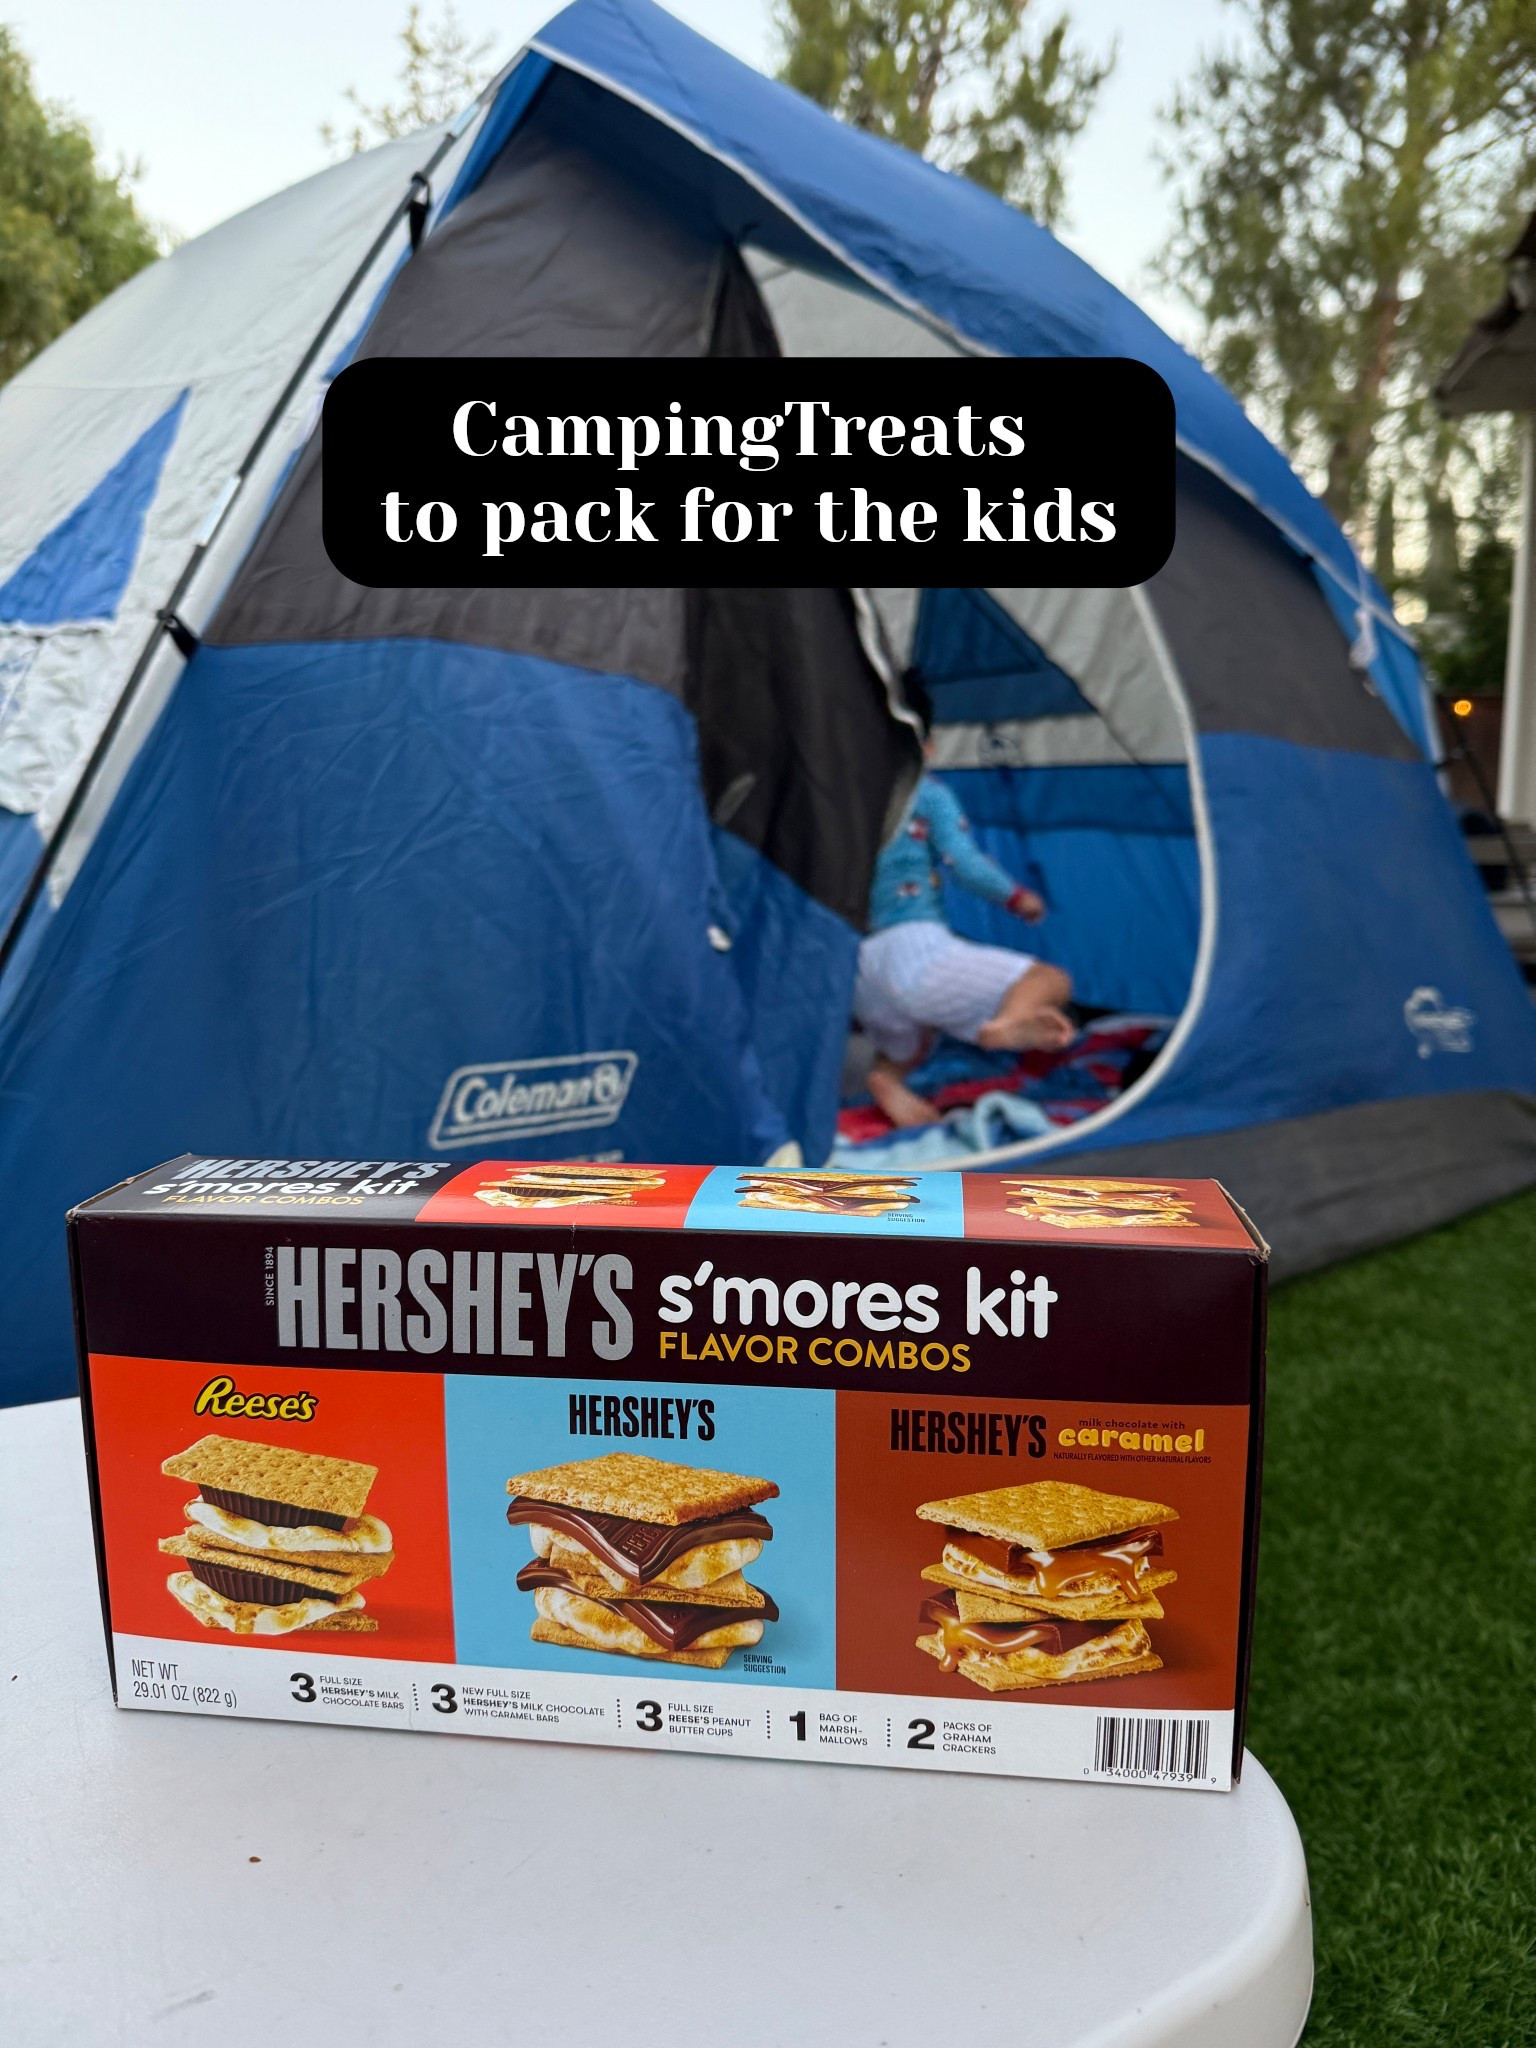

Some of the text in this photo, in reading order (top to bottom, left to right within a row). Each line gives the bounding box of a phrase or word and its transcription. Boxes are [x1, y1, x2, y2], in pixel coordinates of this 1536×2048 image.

[171, 1159, 451, 1180] HERSHEY'S
[142, 1179, 419, 1196] s'mores kit
[161, 1195, 367, 1206] FLAVOR COMBOS
[264, 1246, 275, 1306] SINCE 1894
[276, 1246, 634, 1361] HERSHEY'S
[658, 1260, 1059, 1339] s'mores kit
[659, 1332, 972, 1373] FLAVOR COMBOS
[569, 1394, 715, 1441] HERSHEY'S
[1079, 1418, 1185, 1430] milk chocolate with
[890, 1408, 1047, 1459] HERSHEY'S
[1058, 1428, 1205, 1453] caramel
[1053, 1452, 1212, 1464] NATURALLY FLAVORED WITH OTHER NATURAL FLAVORS
[743, 1654, 773, 1664] SERVING
[131, 1659, 179, 1681] NET WT
[743, 1664, 787, 1674] SUGGESTION
[290, 1672, 317, 1703] 3
[319, 1675, 363, 1686] FULL SIZE
[133, 1680, 239, 1709] 29.01 OZ (822 g)
[320, 1687, 400, 1700] HERSHEY'S MILK
[430, 1683, 458, 1714] 3
[462, 1686, 531, 1700] NEW FULL SIZE
[322, 1697, 405, 1710] CHOCOLATE BARS
[463, 1697, 605, 1716] HERSHEY'S MILK CHOCOLATE
[668, 1702, 714, 1714] FULL SIZE
[464, 1707, 560, 1723] WITH CARAMEL BARS
[635, 1700, 663, 1732] 3
[668, 1714, 751, 1727] REESE'S PEANUT
[819, 1712, 858, 1723] BAG OF
[669, 1725, 733, 1737] BUTTER CUPS
[789, 1710, 806, 1741] 1
[819, 1724, 863, 1735] MARSH-
[943, 1721, 993, 1732] PACKS OF
[819, 1735, 868, 1746] MALLOWS
[907, 1718, 936, 1750] 2
[942, 1732, 992, 1744] GRAHAM
[942, 1743, 997, 1755] CRACKERS
[1106, 1766, 1147, 1779] 34000
[1153, 1770, 1194, 1783] 47939
[1210, 1777, 1217, 1785] 9
